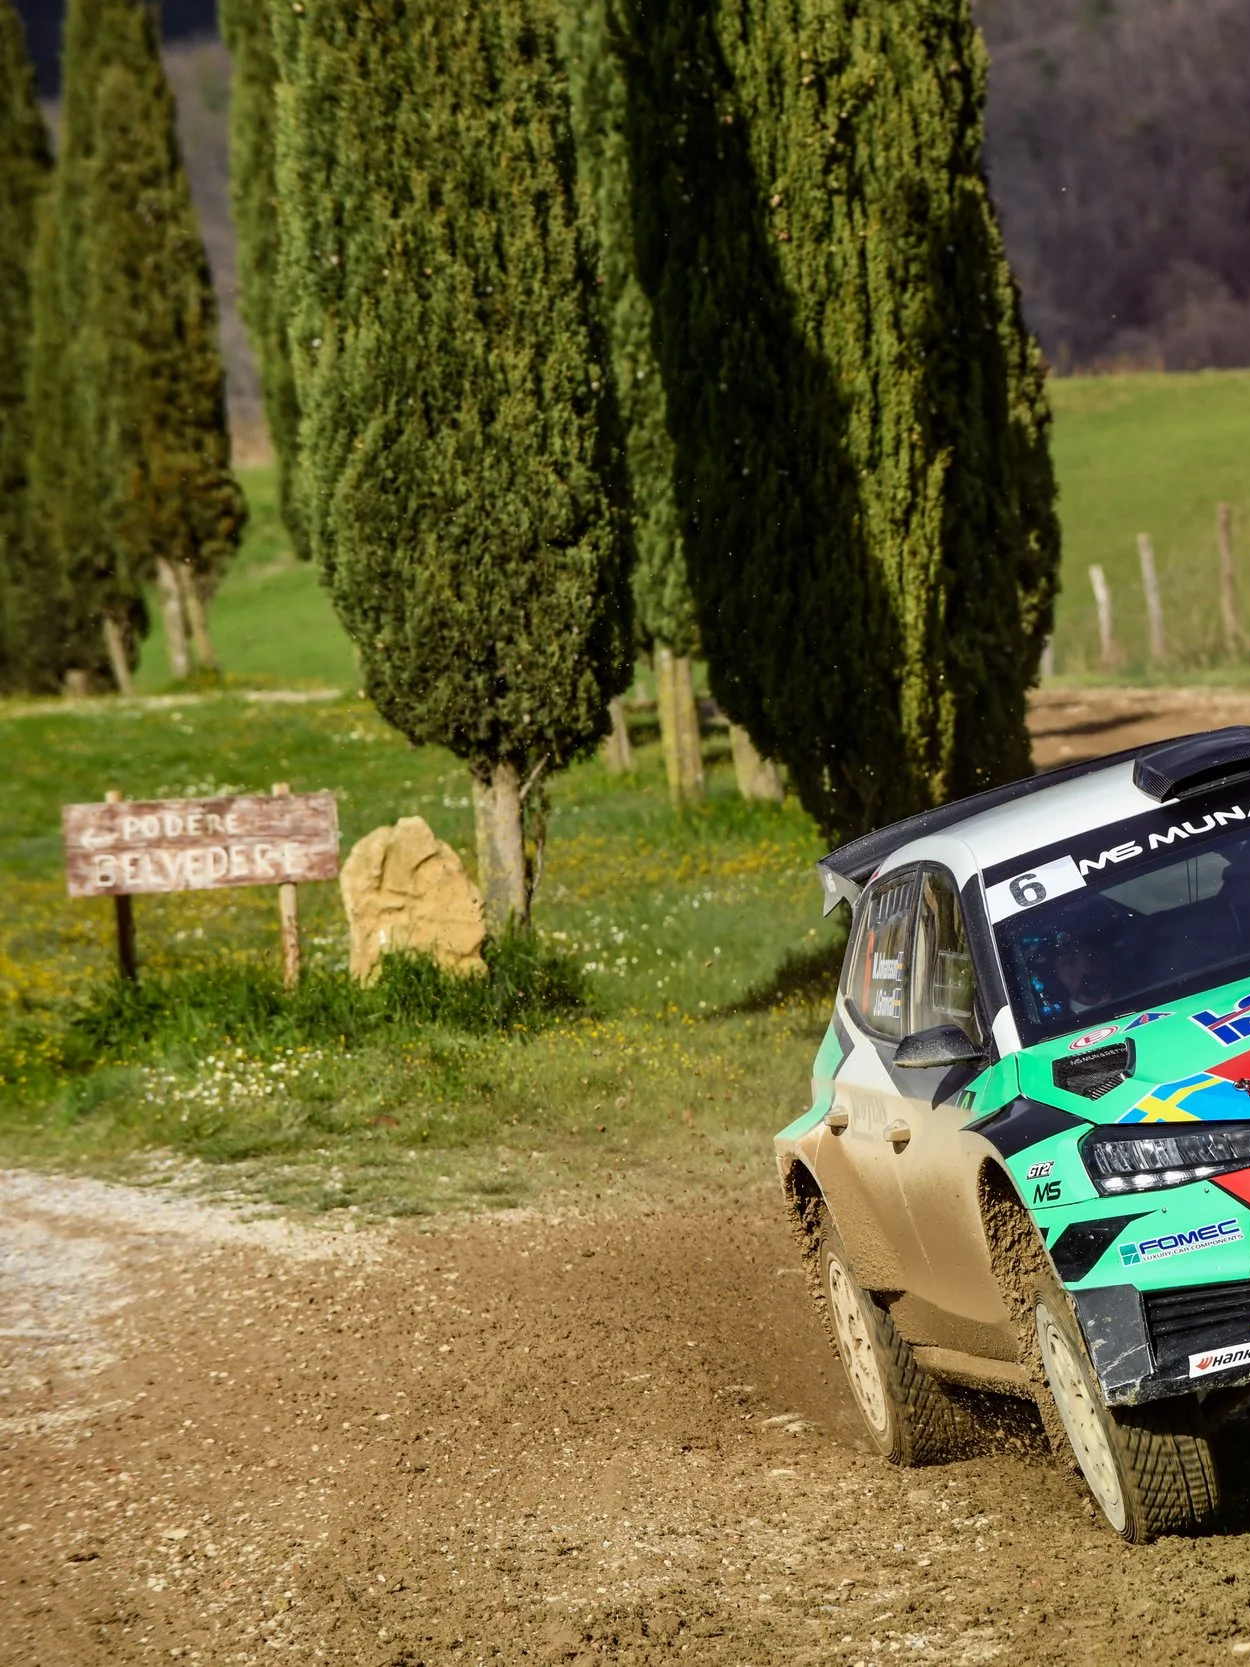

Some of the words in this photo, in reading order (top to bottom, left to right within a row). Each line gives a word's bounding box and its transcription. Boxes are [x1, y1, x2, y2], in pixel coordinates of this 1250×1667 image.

[121, 813, 240, 841] PODERE
[92, 842, 304, 888] BELVEDERE
[1078, 840, 1144, 876] MS
[1008, 873, 1047, 907] 6
[1033, 1180, 1062, 1204] MS
[1139, 1219, 1240, 1255] FOMEC
[1143, 1250, 1172, 1262] LUXURY
[1173, 1246, 1190, 1254] CAR
[1190, 1234, 1244, 1251] COMPONENTS
